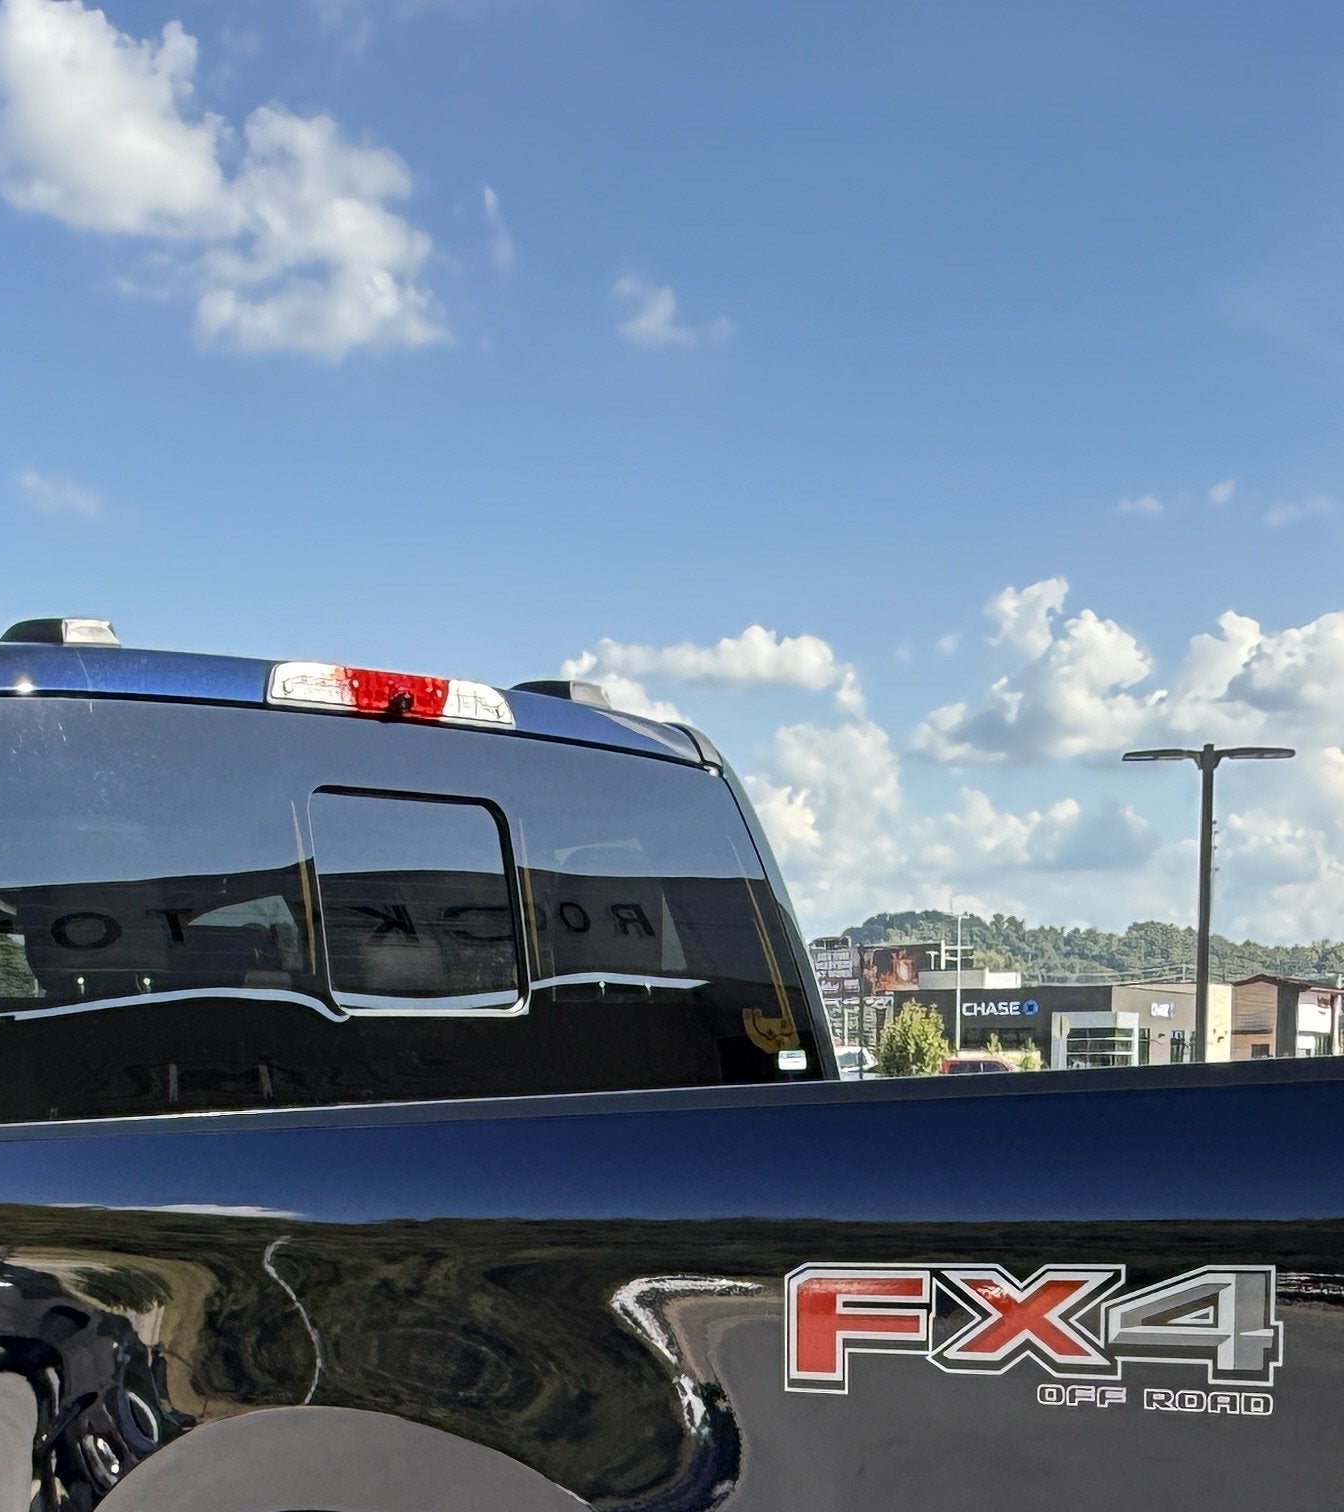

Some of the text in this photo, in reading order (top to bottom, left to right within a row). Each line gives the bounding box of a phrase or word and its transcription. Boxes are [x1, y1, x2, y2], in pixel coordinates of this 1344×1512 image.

[961, 1001, 1022, 1017] CHASE
[784, 1262, 1283, 1394] FX4
[1037, 1383, 1274, 1416] OFF ROAD
